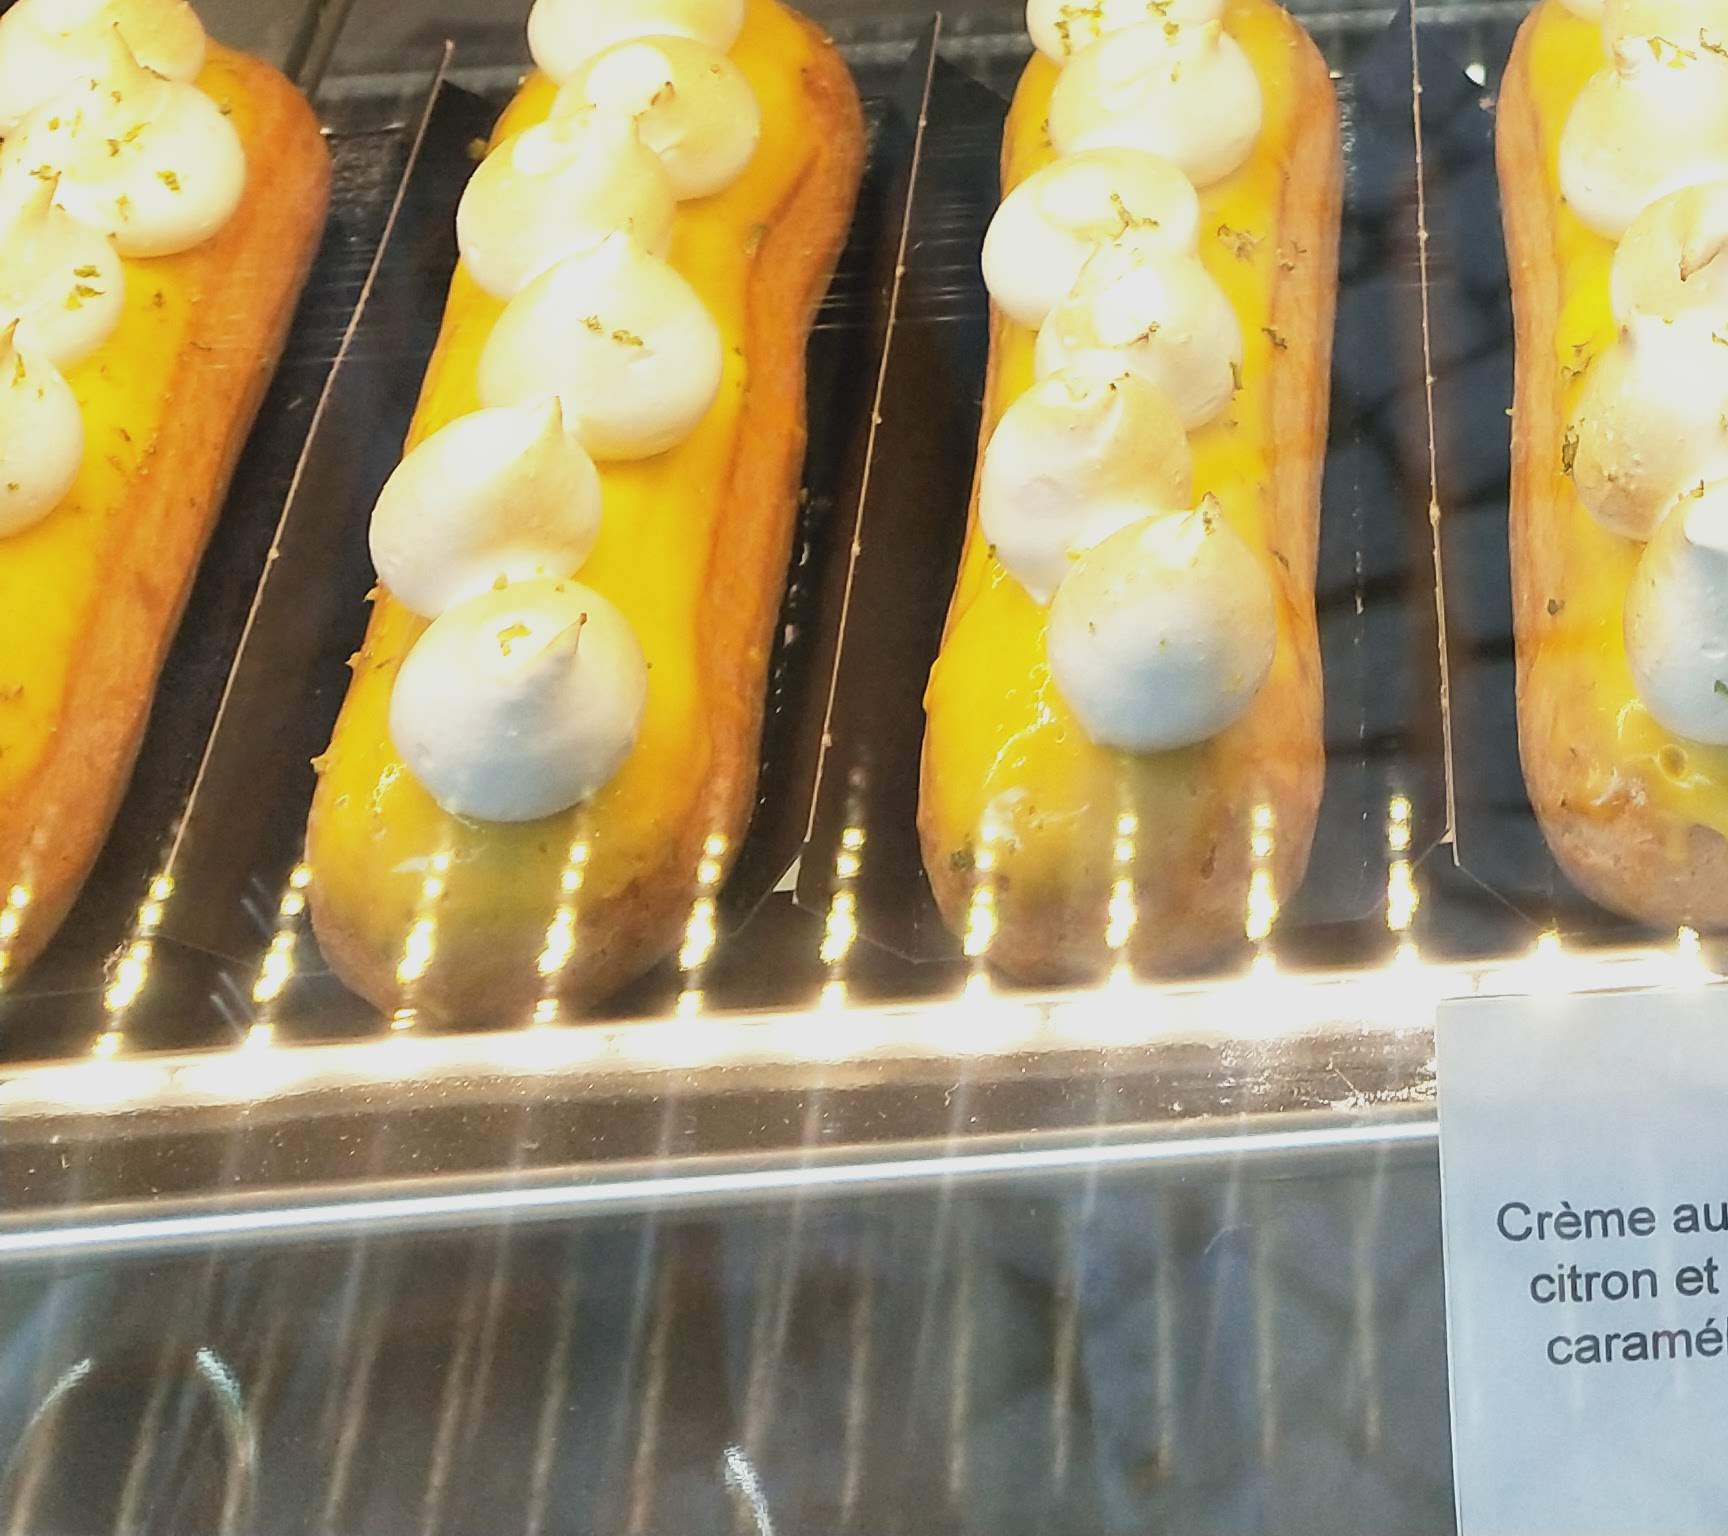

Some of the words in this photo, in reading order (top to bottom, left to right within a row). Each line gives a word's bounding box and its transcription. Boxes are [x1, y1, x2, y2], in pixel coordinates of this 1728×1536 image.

[1496, 1198, 1658, 1243] Crème
[1529, 1259, 1660, 1305] citron
[1675, 1257, 1720, 1295] et
